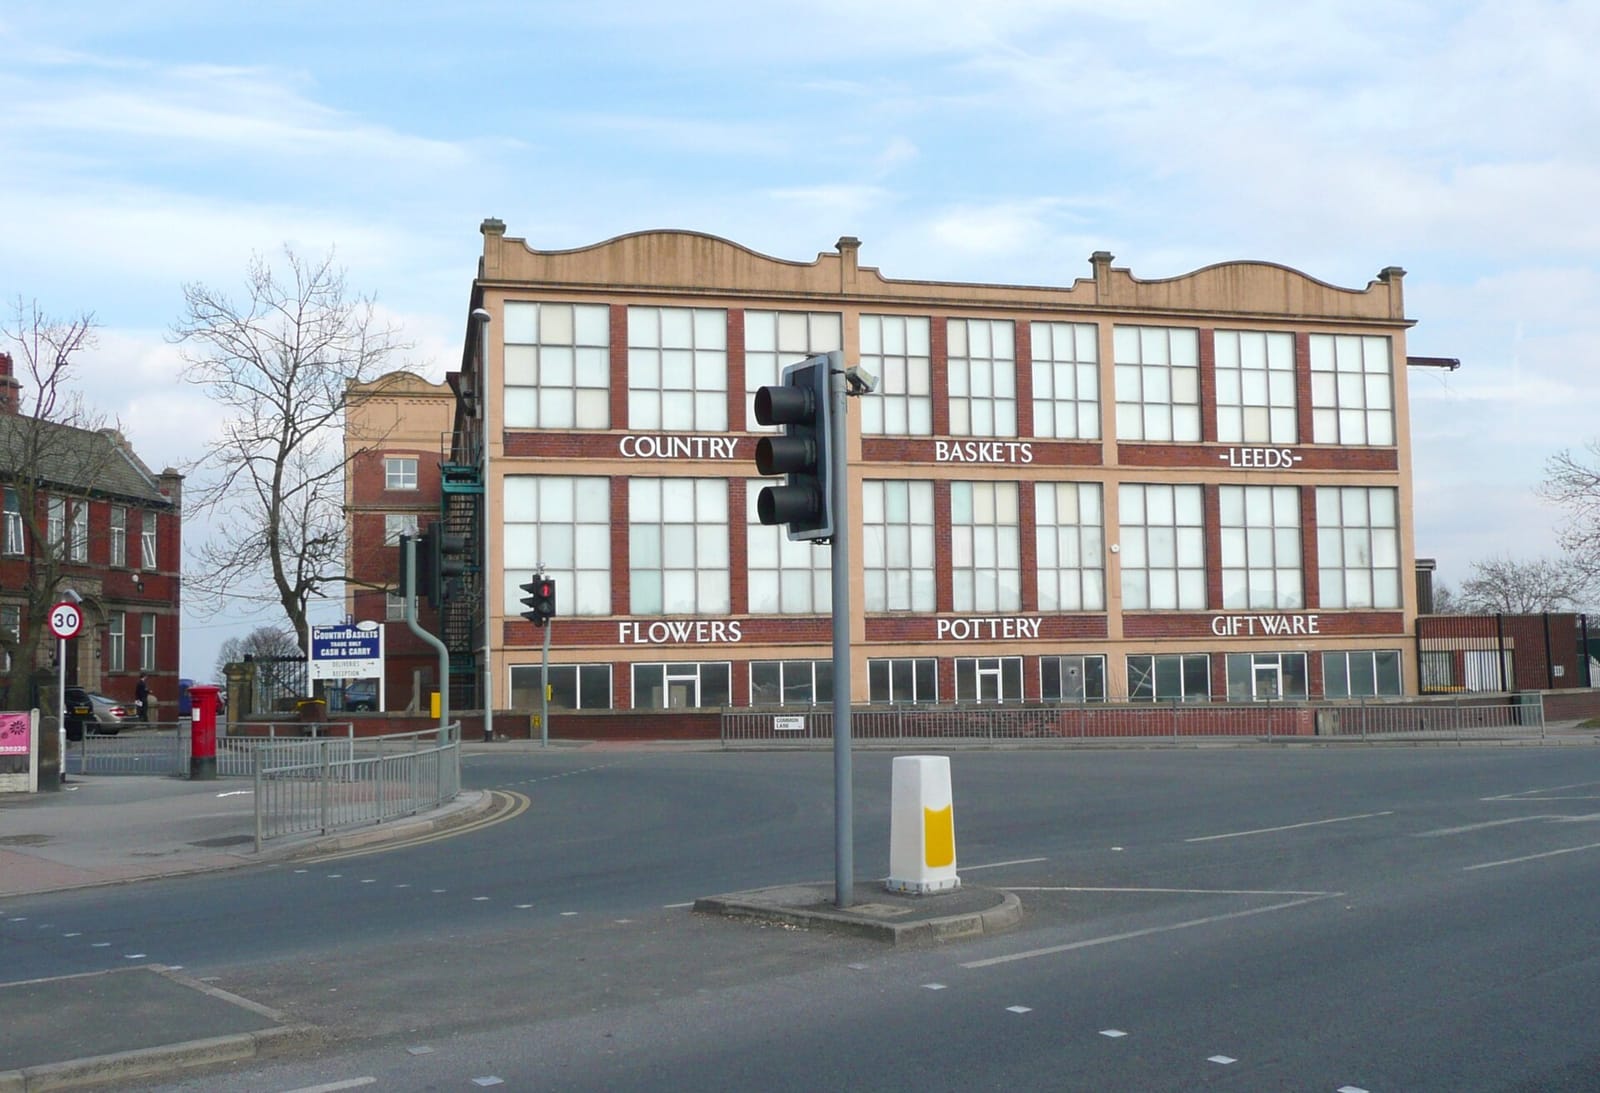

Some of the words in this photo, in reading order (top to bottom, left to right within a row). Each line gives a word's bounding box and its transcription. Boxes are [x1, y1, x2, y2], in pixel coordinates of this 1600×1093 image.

[619, 436, 738, 458] COUNTRY
[935, 441, 1033, 463] BASKETS
[54, 613, 77, 628] 30
[937, 618, 1042, 640] POTTERY
[1212, 615, 1320, 636] GIFTWARE
[619, 621, 742, 643] FLOWERS
[320, 648, 339, 656] CASH
[348, 647, 371, 655] CARRY
